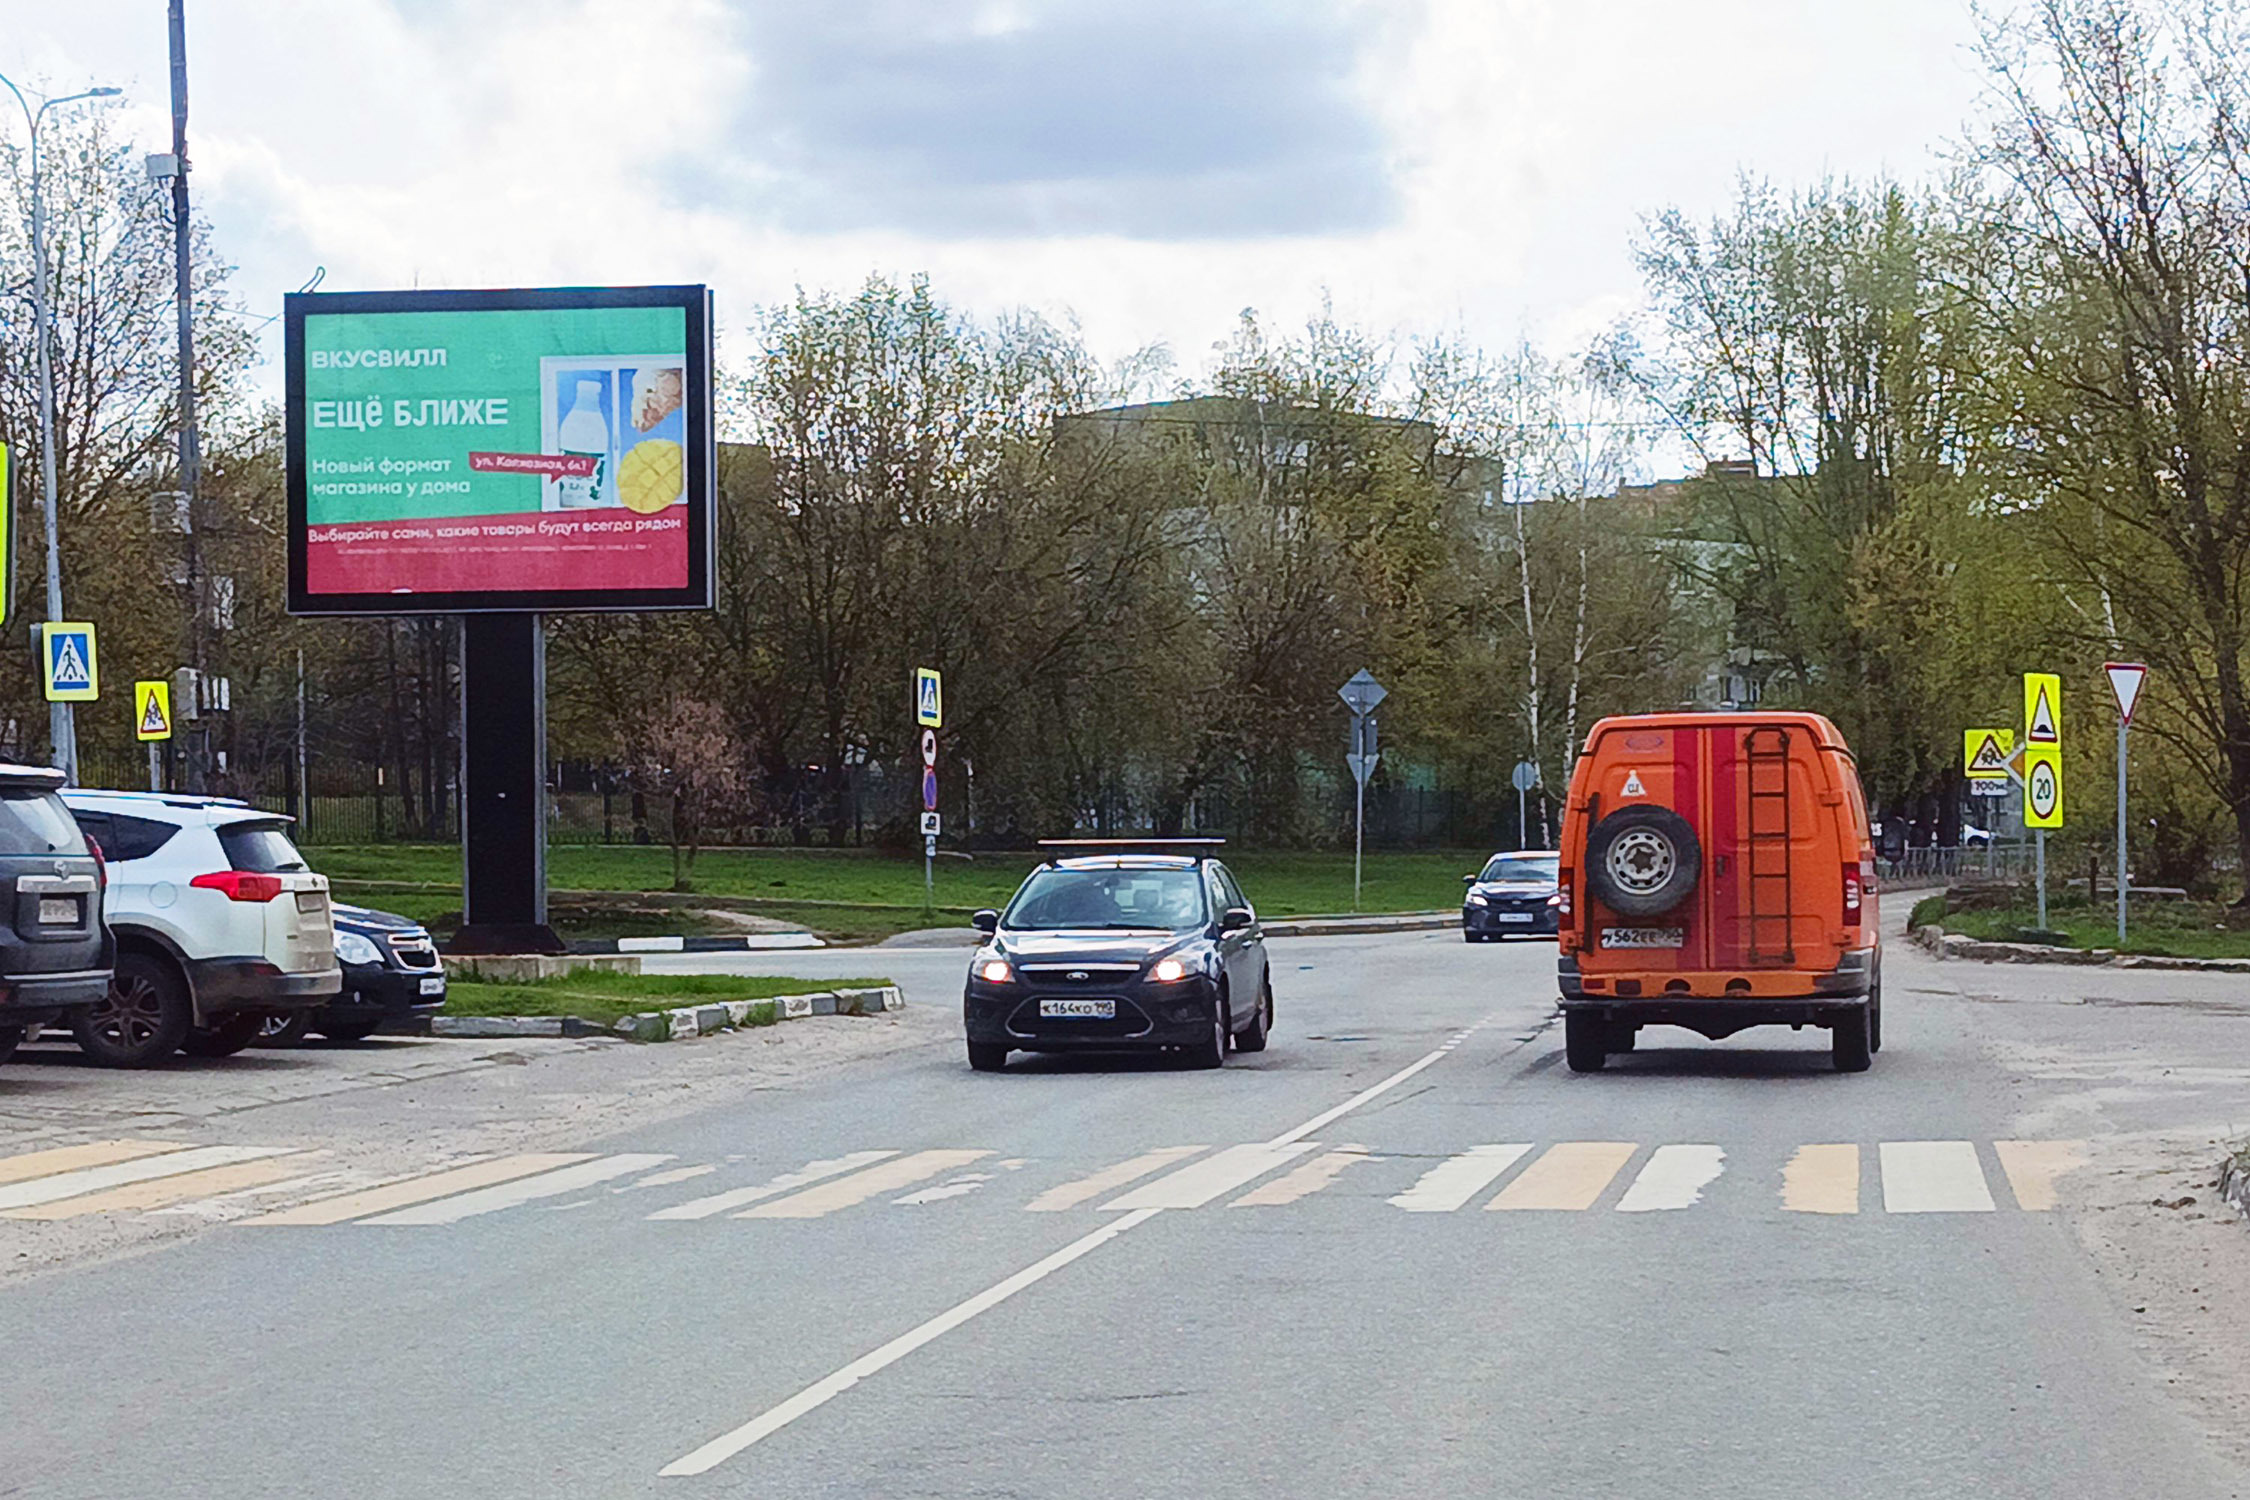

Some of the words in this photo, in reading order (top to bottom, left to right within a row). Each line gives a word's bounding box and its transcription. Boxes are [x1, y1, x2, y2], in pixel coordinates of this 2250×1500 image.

[312, 349, 447, 368] ВКУСВИЛЛ
[394, 398, 509, 427] БЛИЖЕ
[312, 457, 375, 474] Новый
[378, 457, 452, 476] формат
[312, 482, 402, 496] магазина
[405, 482, 418, 498] у
[420, 480, 471, 496] дома
[308, 527, 388, 543] Выбирайте
[392, 528, 434, 540] сами,
[437, 525, 479, 538] какие
[482, 523, 535, 537] товары
[538, 520, 579, 536] будут
[583, 520, 632, 533] всегда
[635, 518, 682, 533] рядом
[2036, 778, 2052, 800] 20
